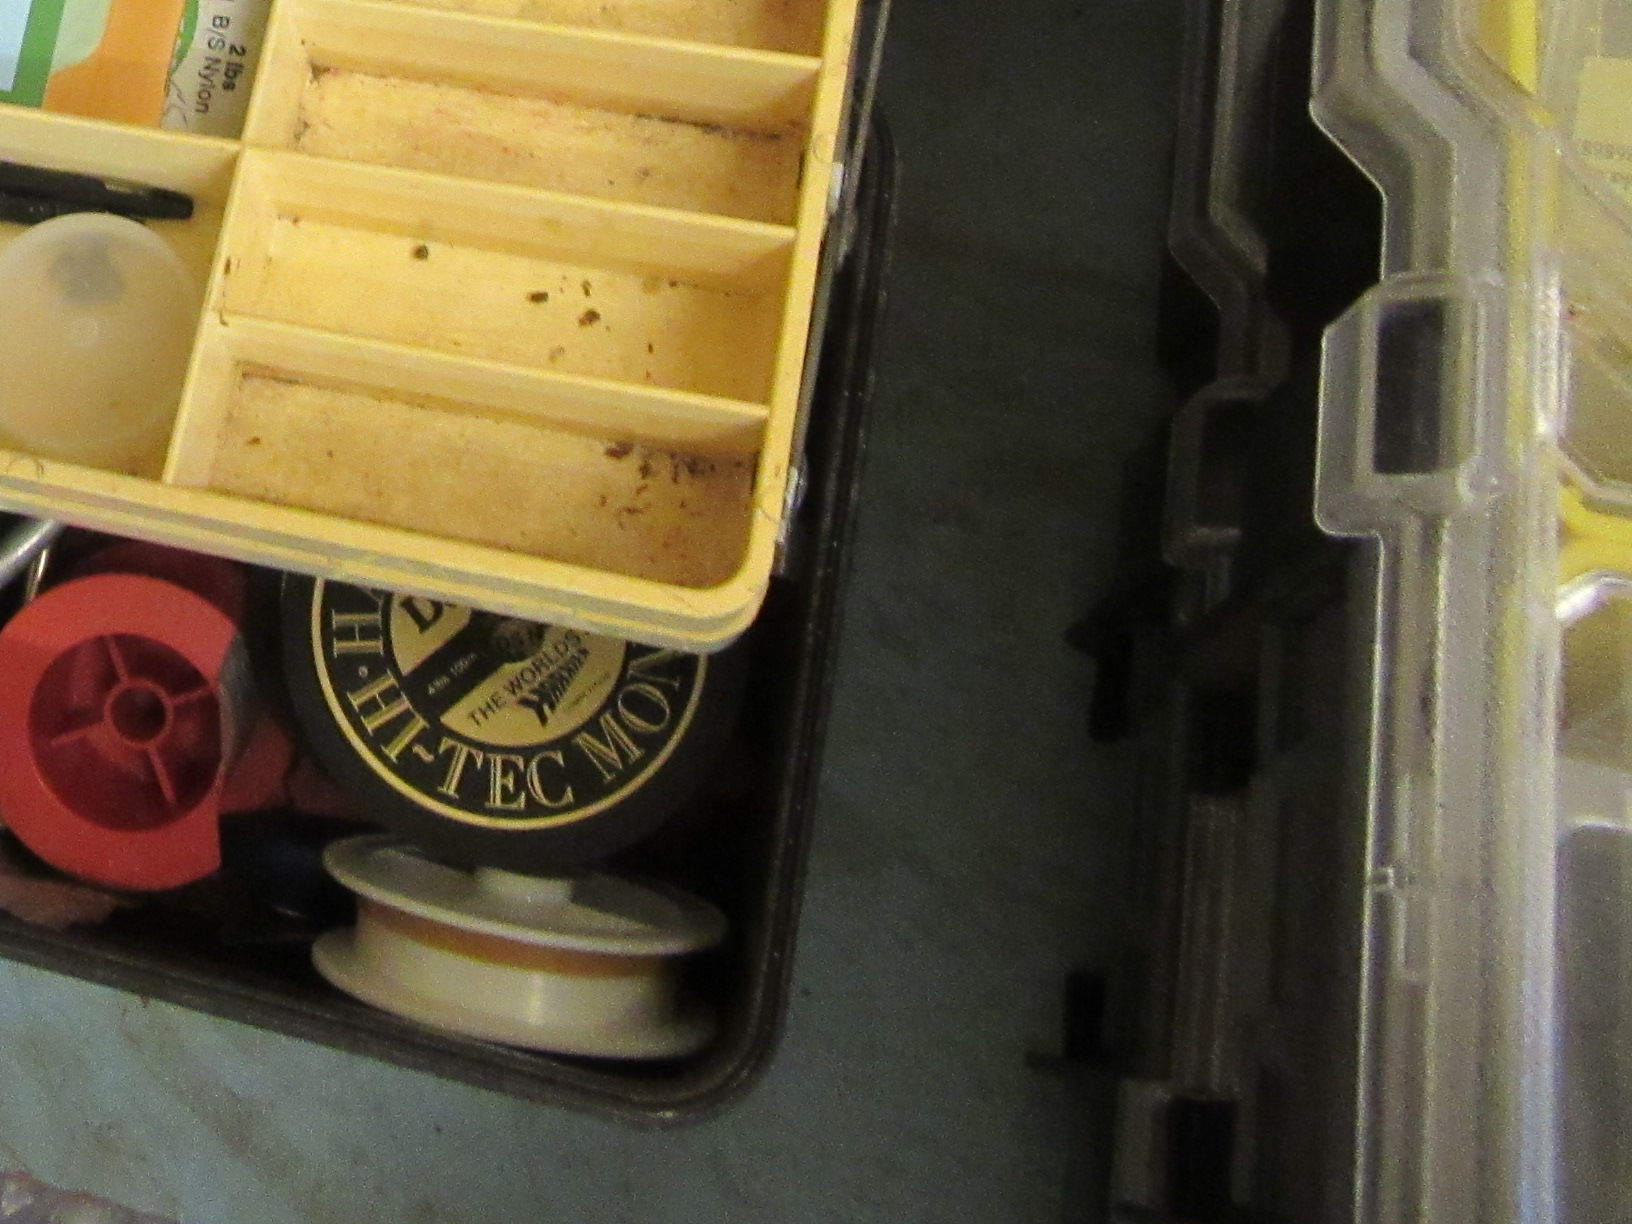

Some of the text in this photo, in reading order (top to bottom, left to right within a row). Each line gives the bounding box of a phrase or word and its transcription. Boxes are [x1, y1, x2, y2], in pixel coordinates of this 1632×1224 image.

[195, 14, 230, 113] B/S Nylon
[223, 44, 246, 92] 2 lbs
[467, 690, 506, 726] THE
